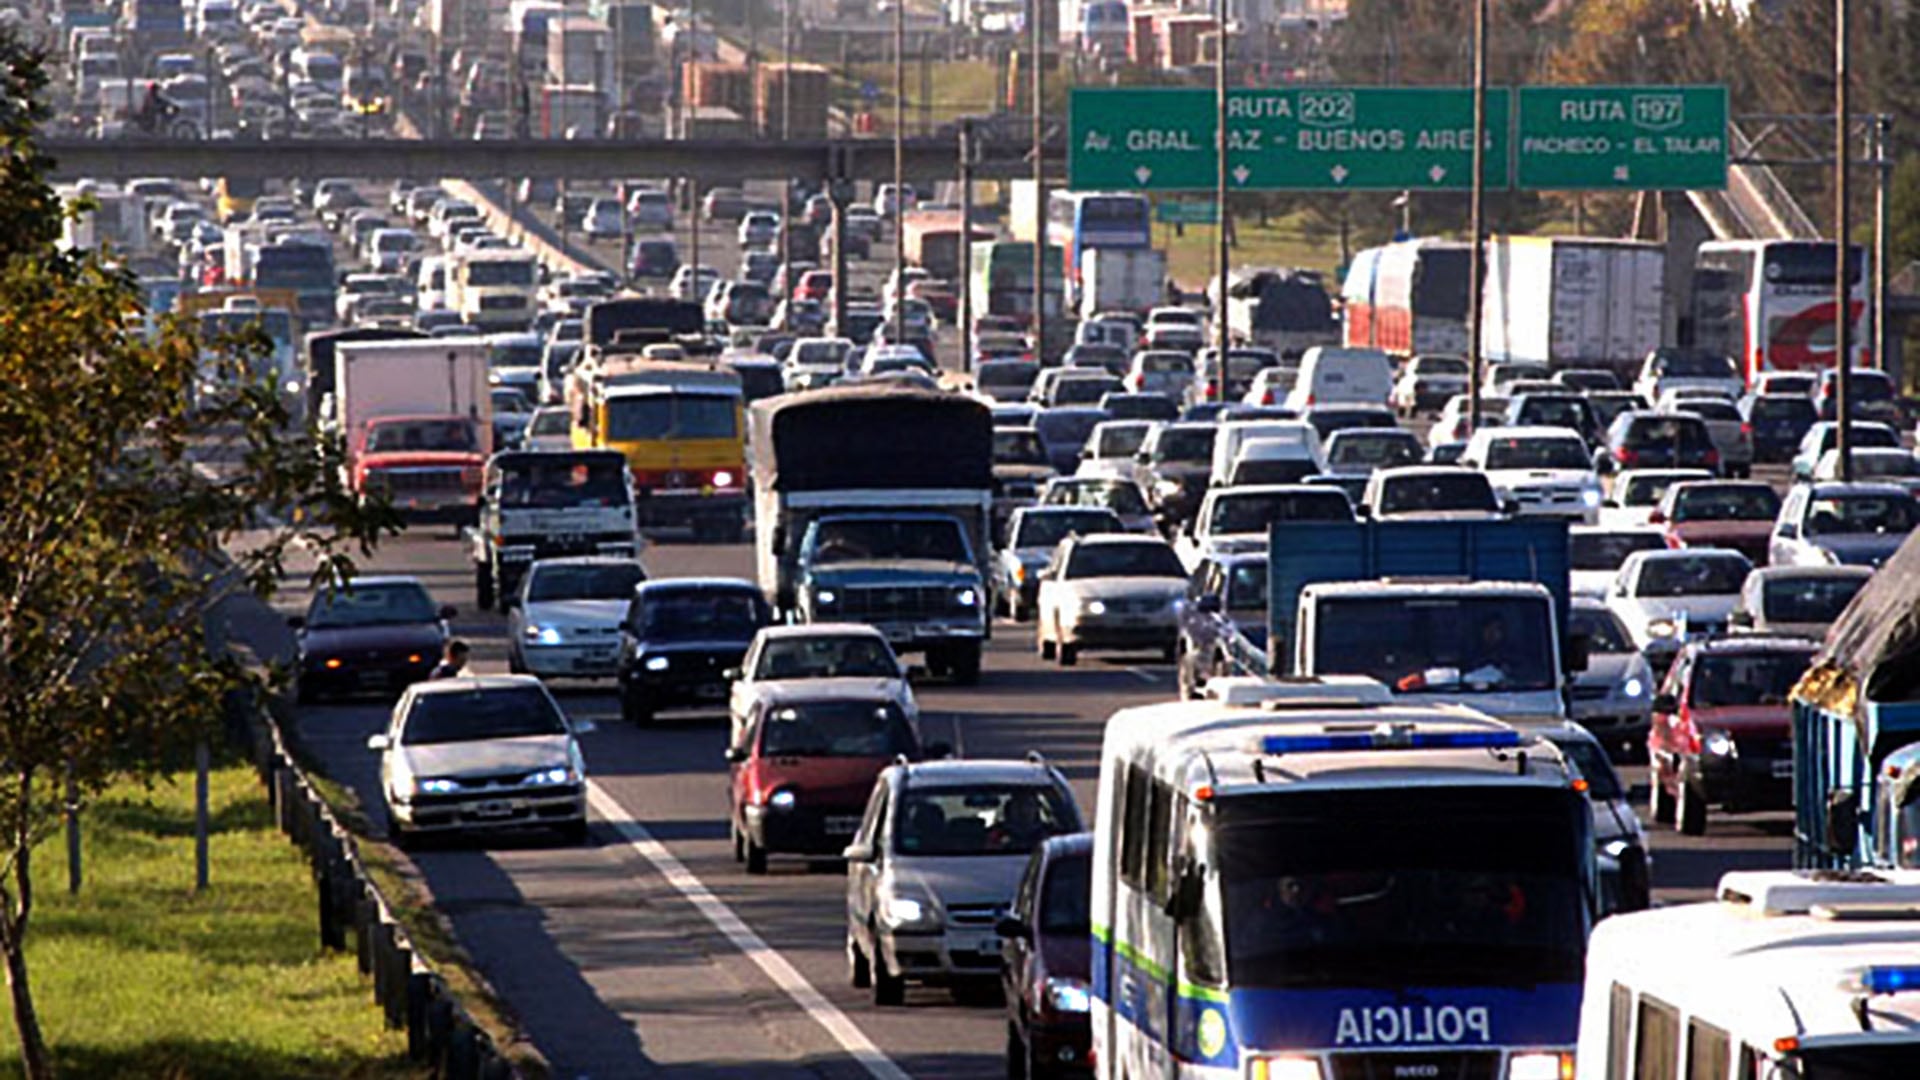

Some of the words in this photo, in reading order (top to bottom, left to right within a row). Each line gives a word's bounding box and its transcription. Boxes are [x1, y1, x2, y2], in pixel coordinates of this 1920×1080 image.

[1227, 97, 1291, 118] RUTA
[1303, 97, 1351, 118] 202
[1561, 100, 1626, 121] RUTA
[1638, 100, 1678, 120] 197
[1299, 130, 1405, 151] BUENOS
[1523, 136, 1610, 154] PACHECO
[1634, 137, 1656, 153] EL
[1664, 136, 1721, 153] TALAR
